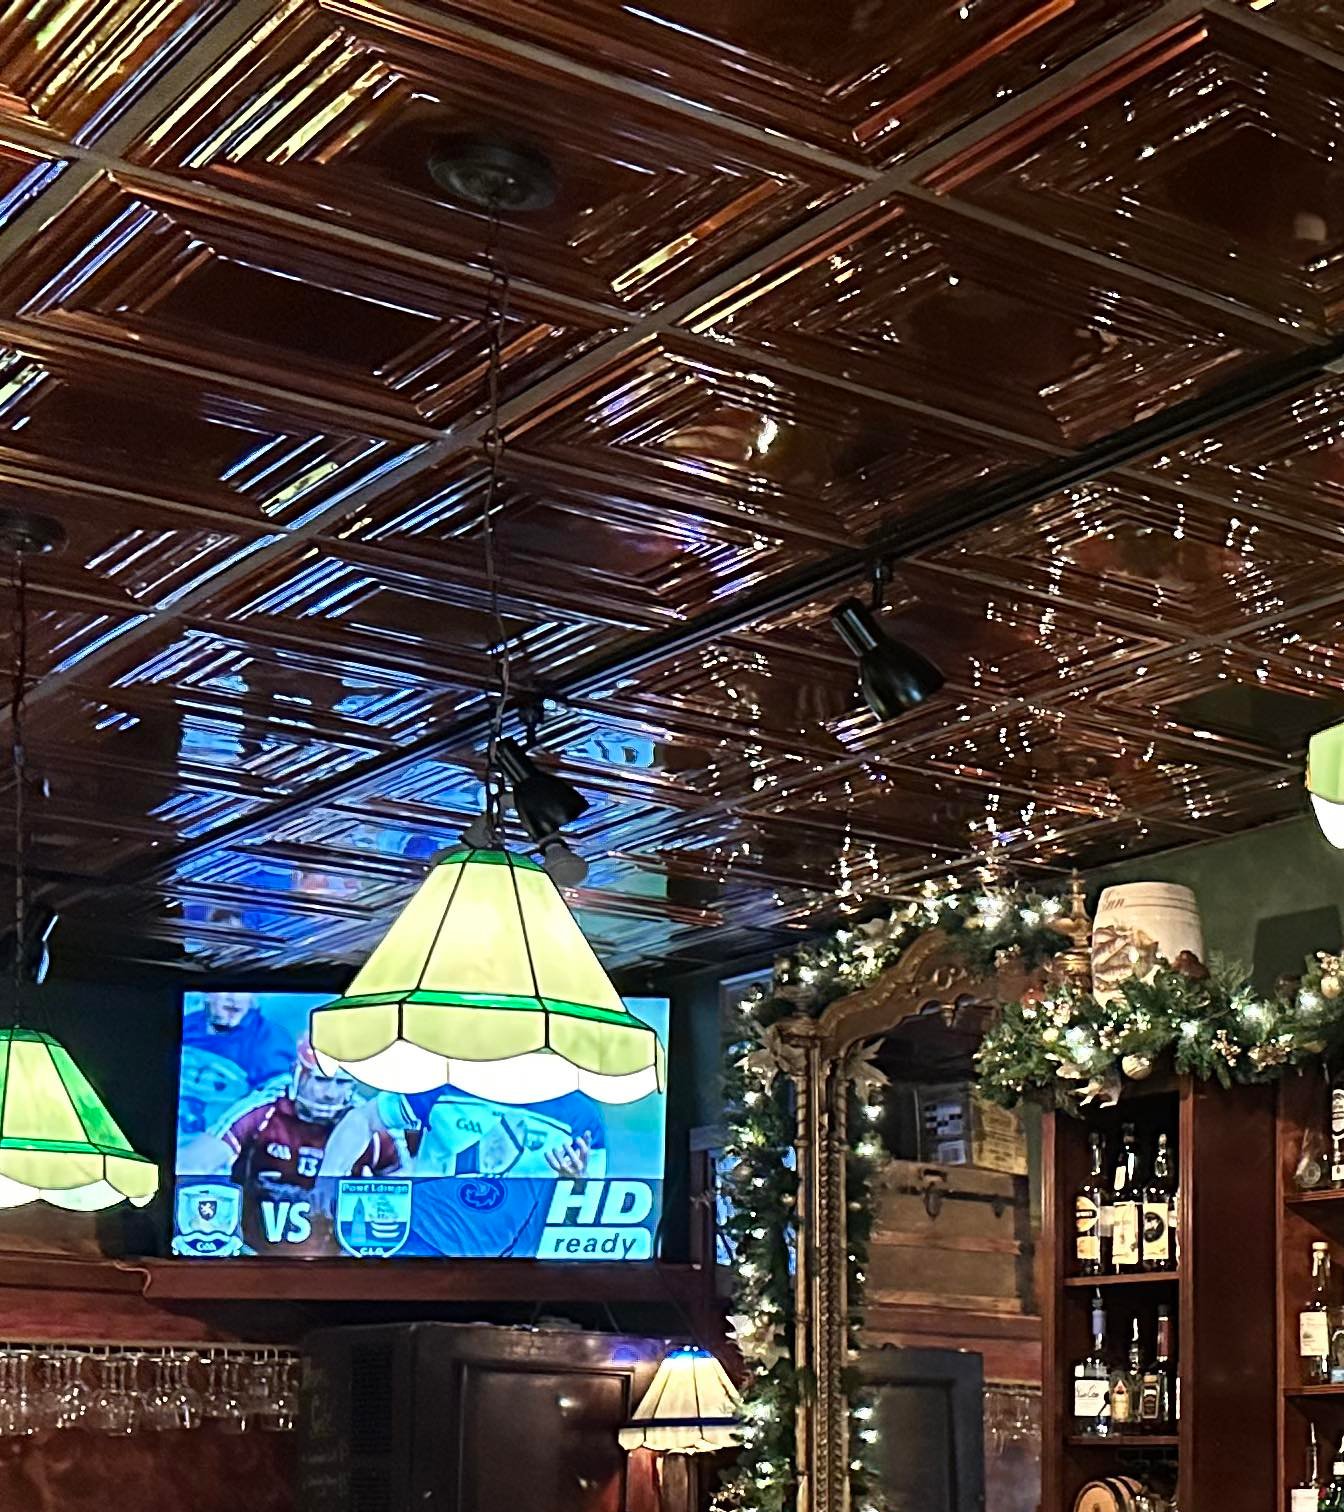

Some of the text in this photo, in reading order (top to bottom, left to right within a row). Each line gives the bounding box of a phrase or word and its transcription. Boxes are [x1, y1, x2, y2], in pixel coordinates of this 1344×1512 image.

[261, 1201, 311, 1243] VS
[547, 1181, 653, 1225] HD
[553, 1231, 638, 1259] ready
